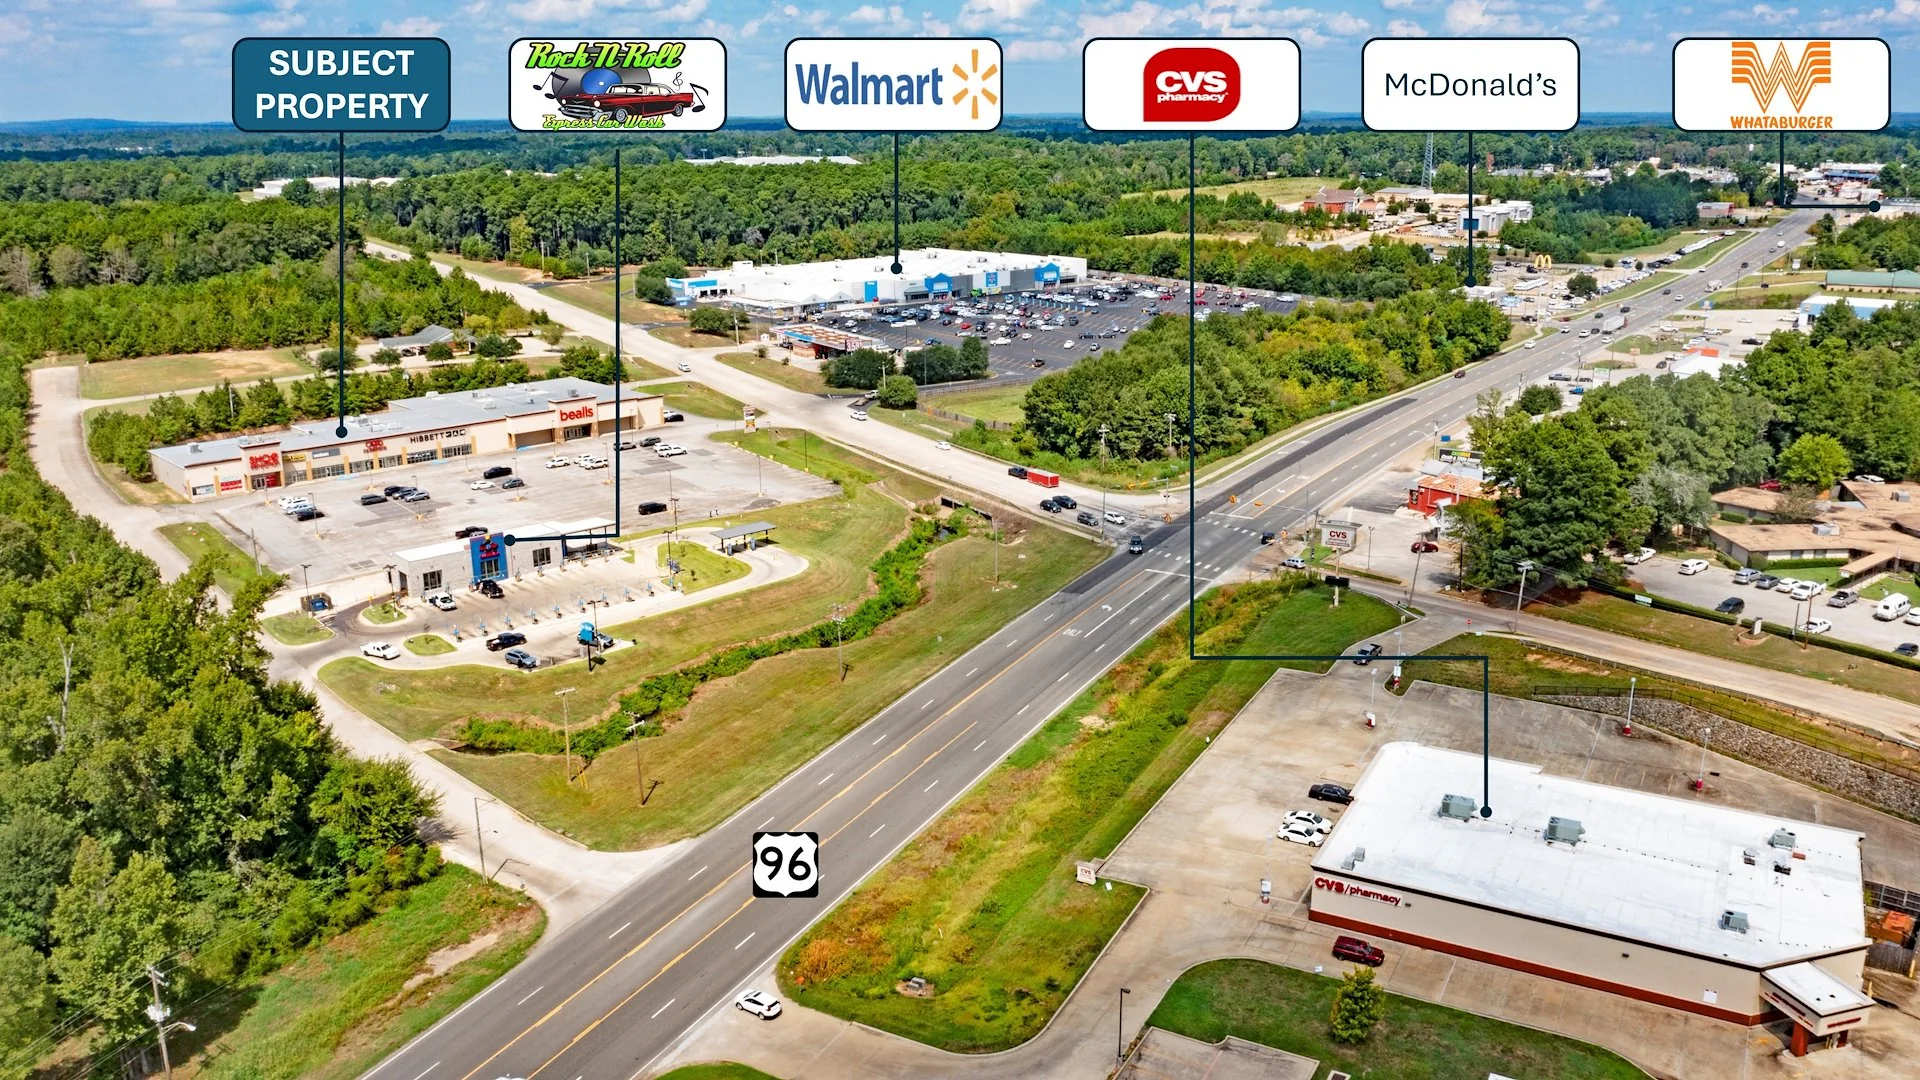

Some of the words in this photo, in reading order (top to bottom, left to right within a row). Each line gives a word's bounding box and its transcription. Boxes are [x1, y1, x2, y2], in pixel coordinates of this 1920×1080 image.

[560, 406, 594, 422] bealls
[410, 431, 444, 444] HIBBETT
[1329, 530, 1347, 539] CVS
[1314, 877, 1401, 906] CVS/pharmacy
